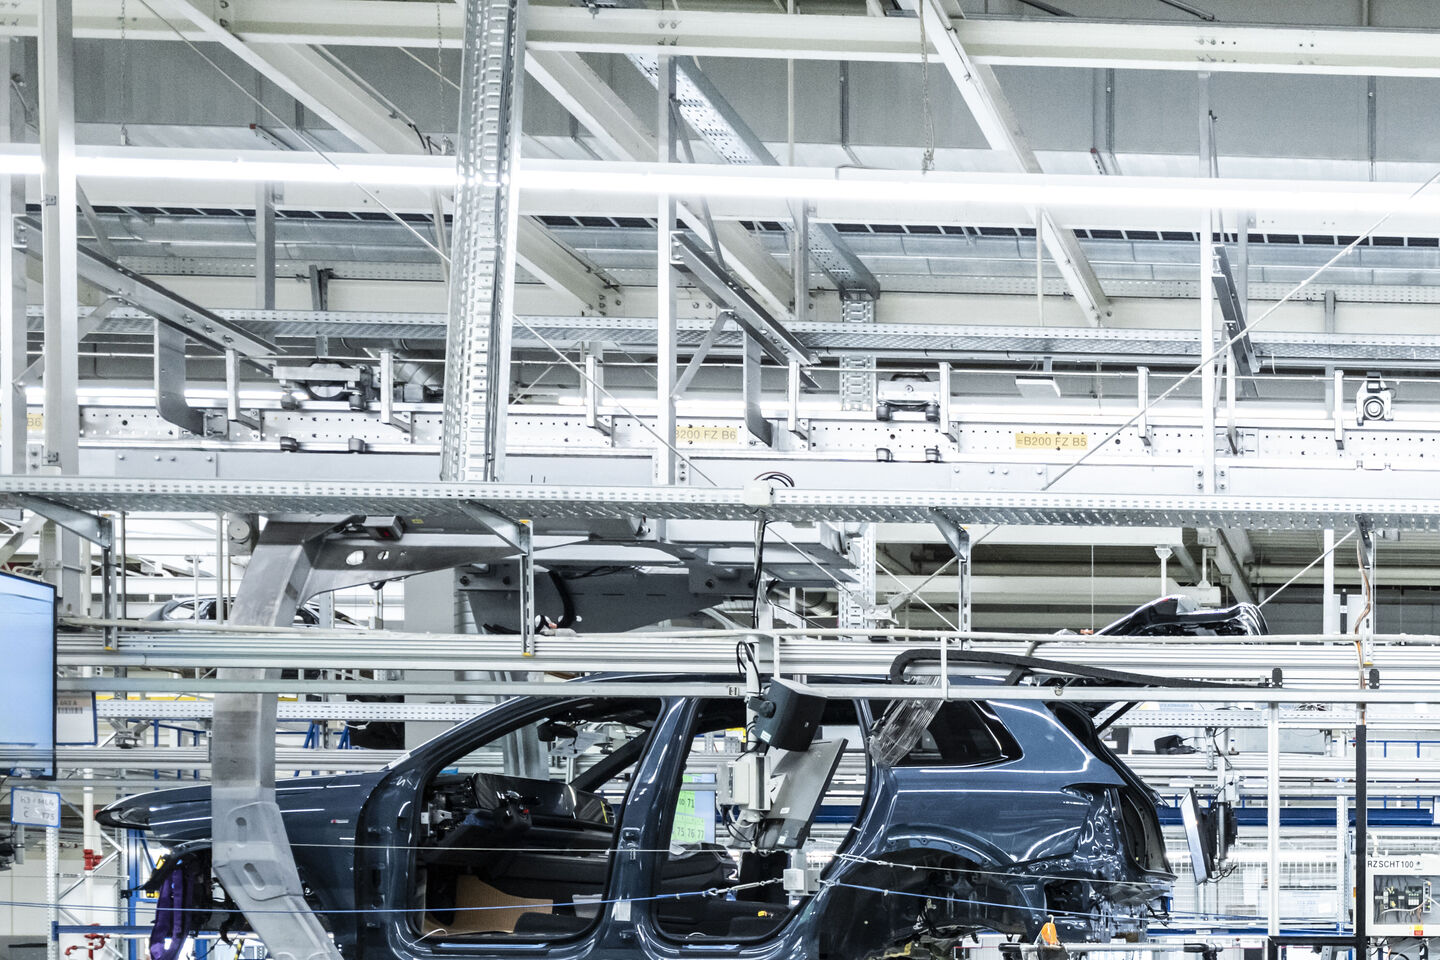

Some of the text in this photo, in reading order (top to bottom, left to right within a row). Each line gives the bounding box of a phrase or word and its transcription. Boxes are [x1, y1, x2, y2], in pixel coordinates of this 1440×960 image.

[704, 431, 718, 440] FZ
[722, 431, 736, 440] B6
[1055, 437, 1069, 446] FZ
[1073, 437, 1087, 447] B5
